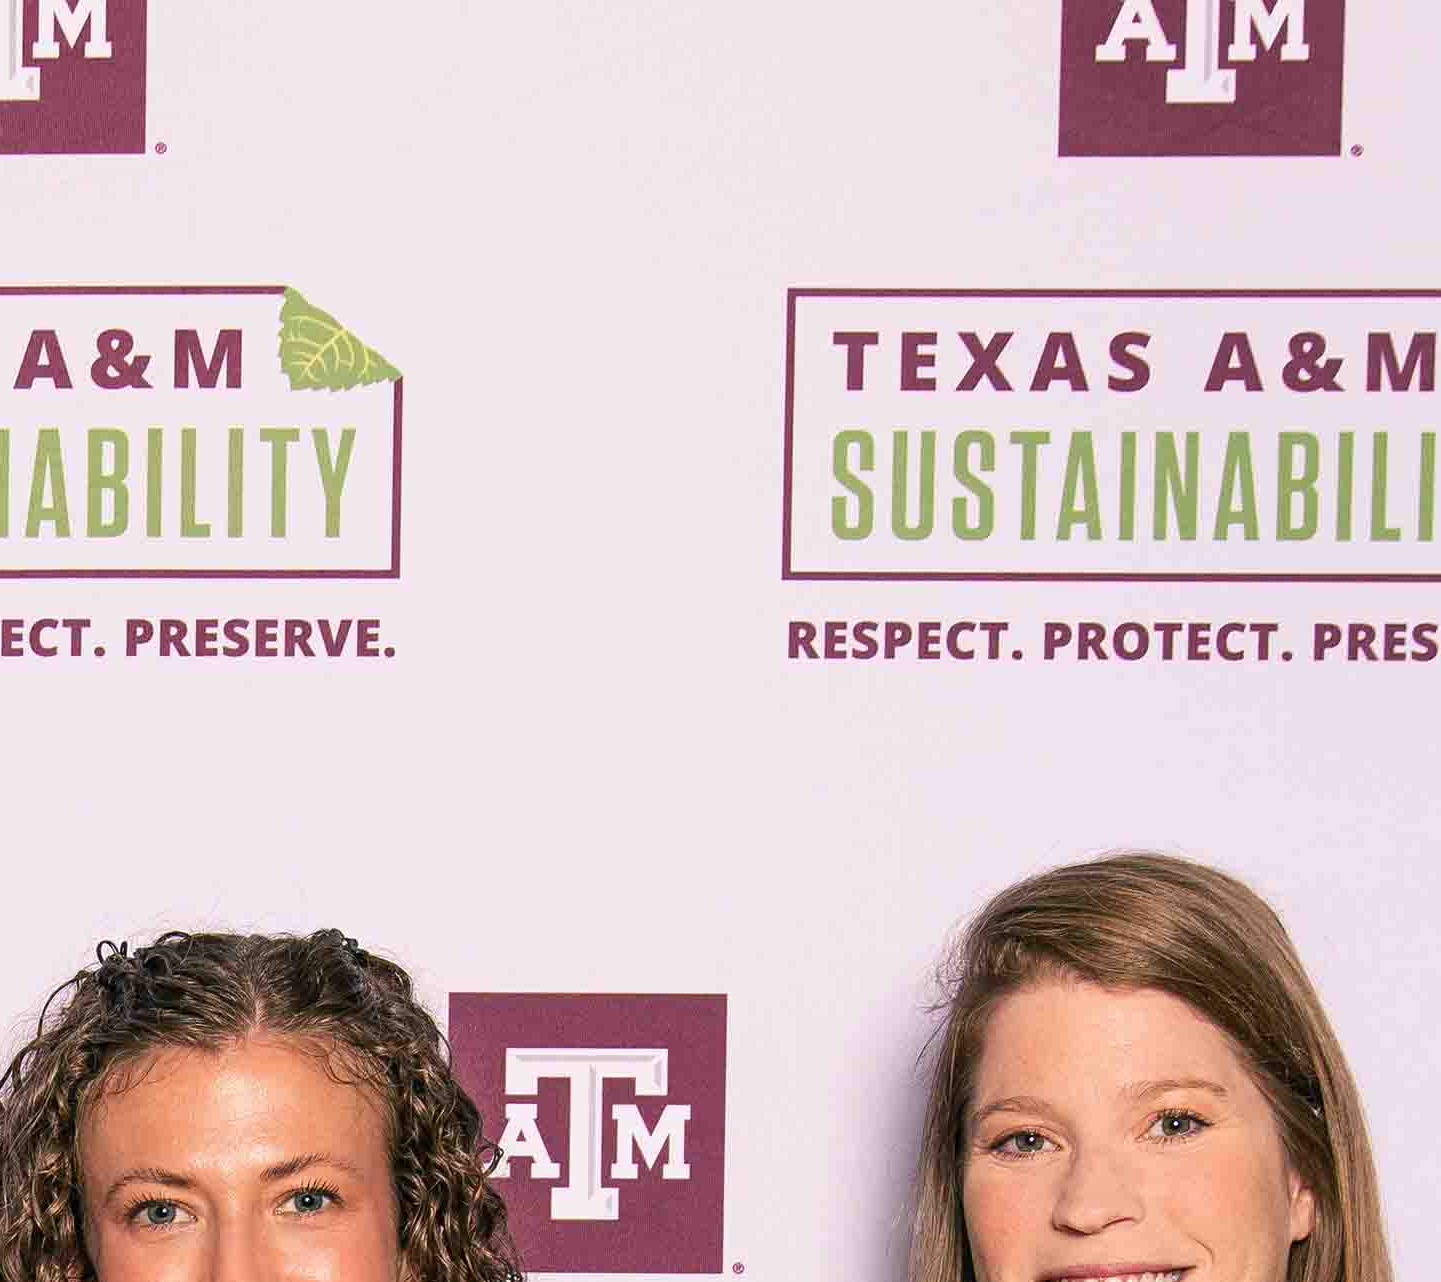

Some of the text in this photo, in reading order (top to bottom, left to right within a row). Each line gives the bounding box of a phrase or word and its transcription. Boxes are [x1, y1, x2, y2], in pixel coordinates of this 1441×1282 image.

[14, 329, 242, 389] A&M
[833, 332, 1436, 392] TEXAS A&M
[126, 619, 395, 657] PRESERVE.
[788, 621, 1022, 660] RESPECT.
[1044, 622, 1292, 661] PROTECT.
